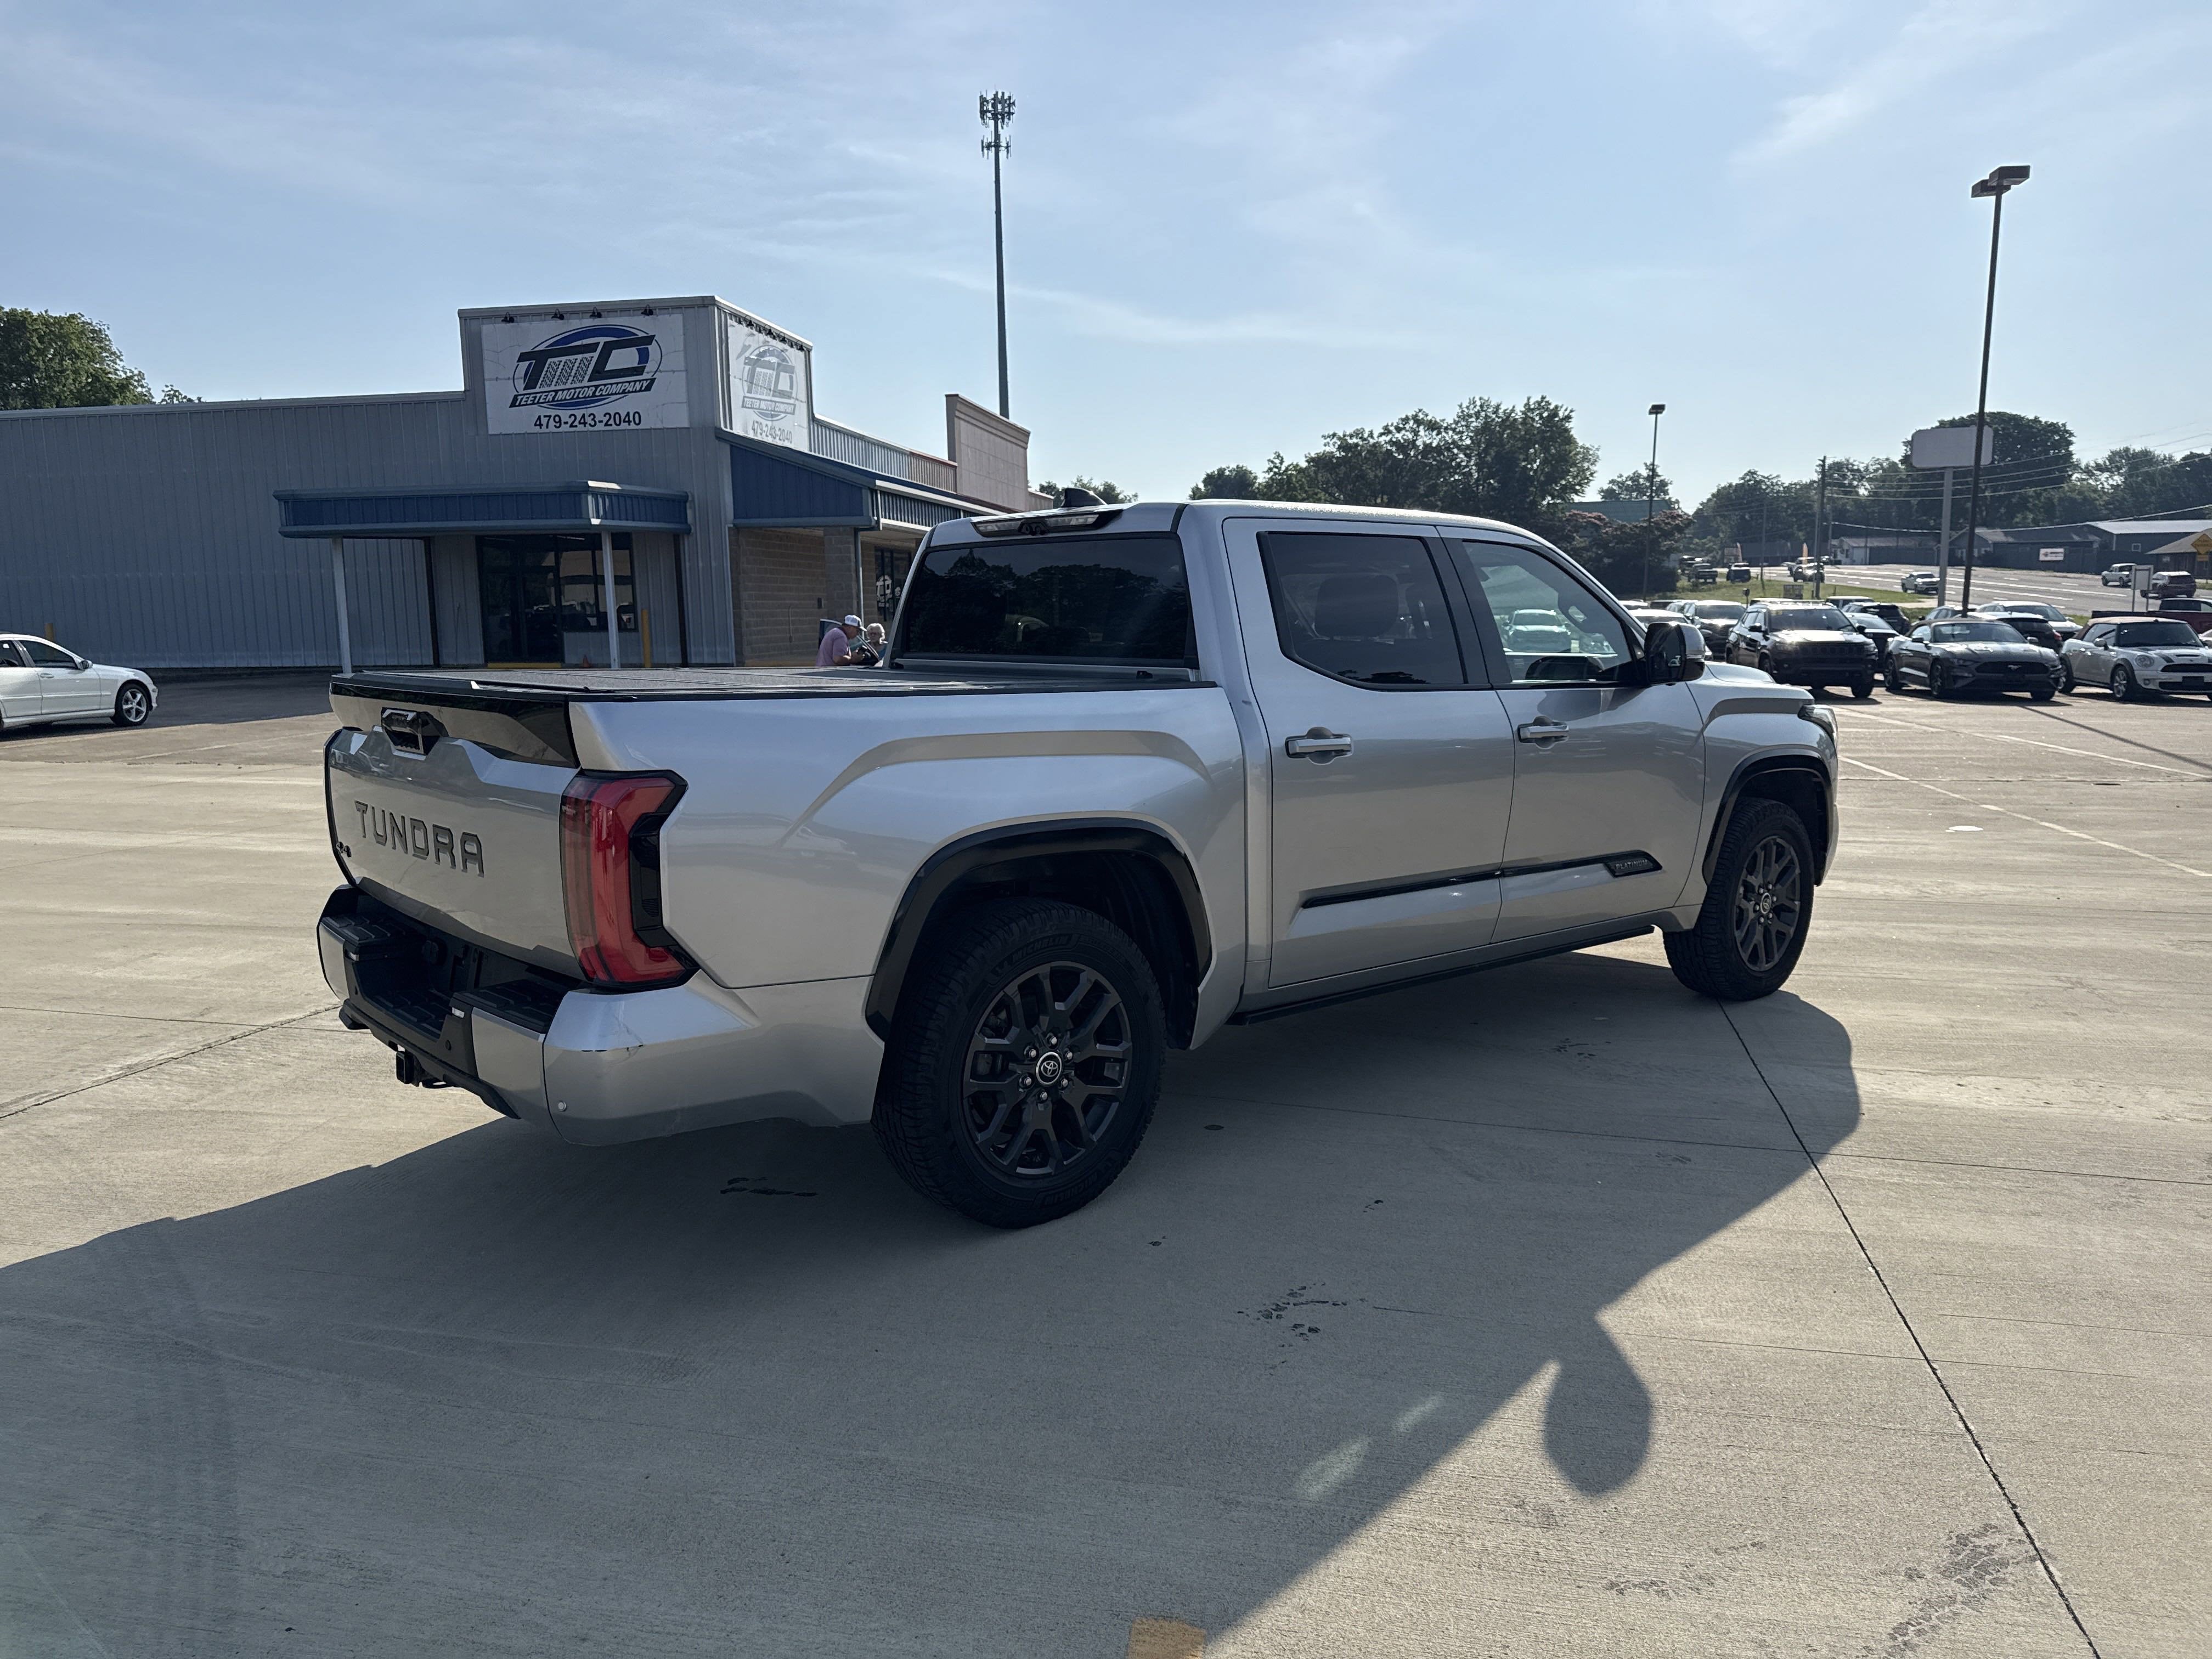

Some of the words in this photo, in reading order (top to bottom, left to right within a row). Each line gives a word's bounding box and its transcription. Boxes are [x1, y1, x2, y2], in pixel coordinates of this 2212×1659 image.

[515, 391, 553, 406] TEETER
[555, 387, 595, 401] MOTOR
[595, 380, 650, 397] COMPANY
[533, 411, 642, 430] 479-243-2040
[752, 420, 793, 444] 479-243-2040
[354, 800, 484, 878] TUNDRA
[1615, 859, 1647, 870] PLATINUM
